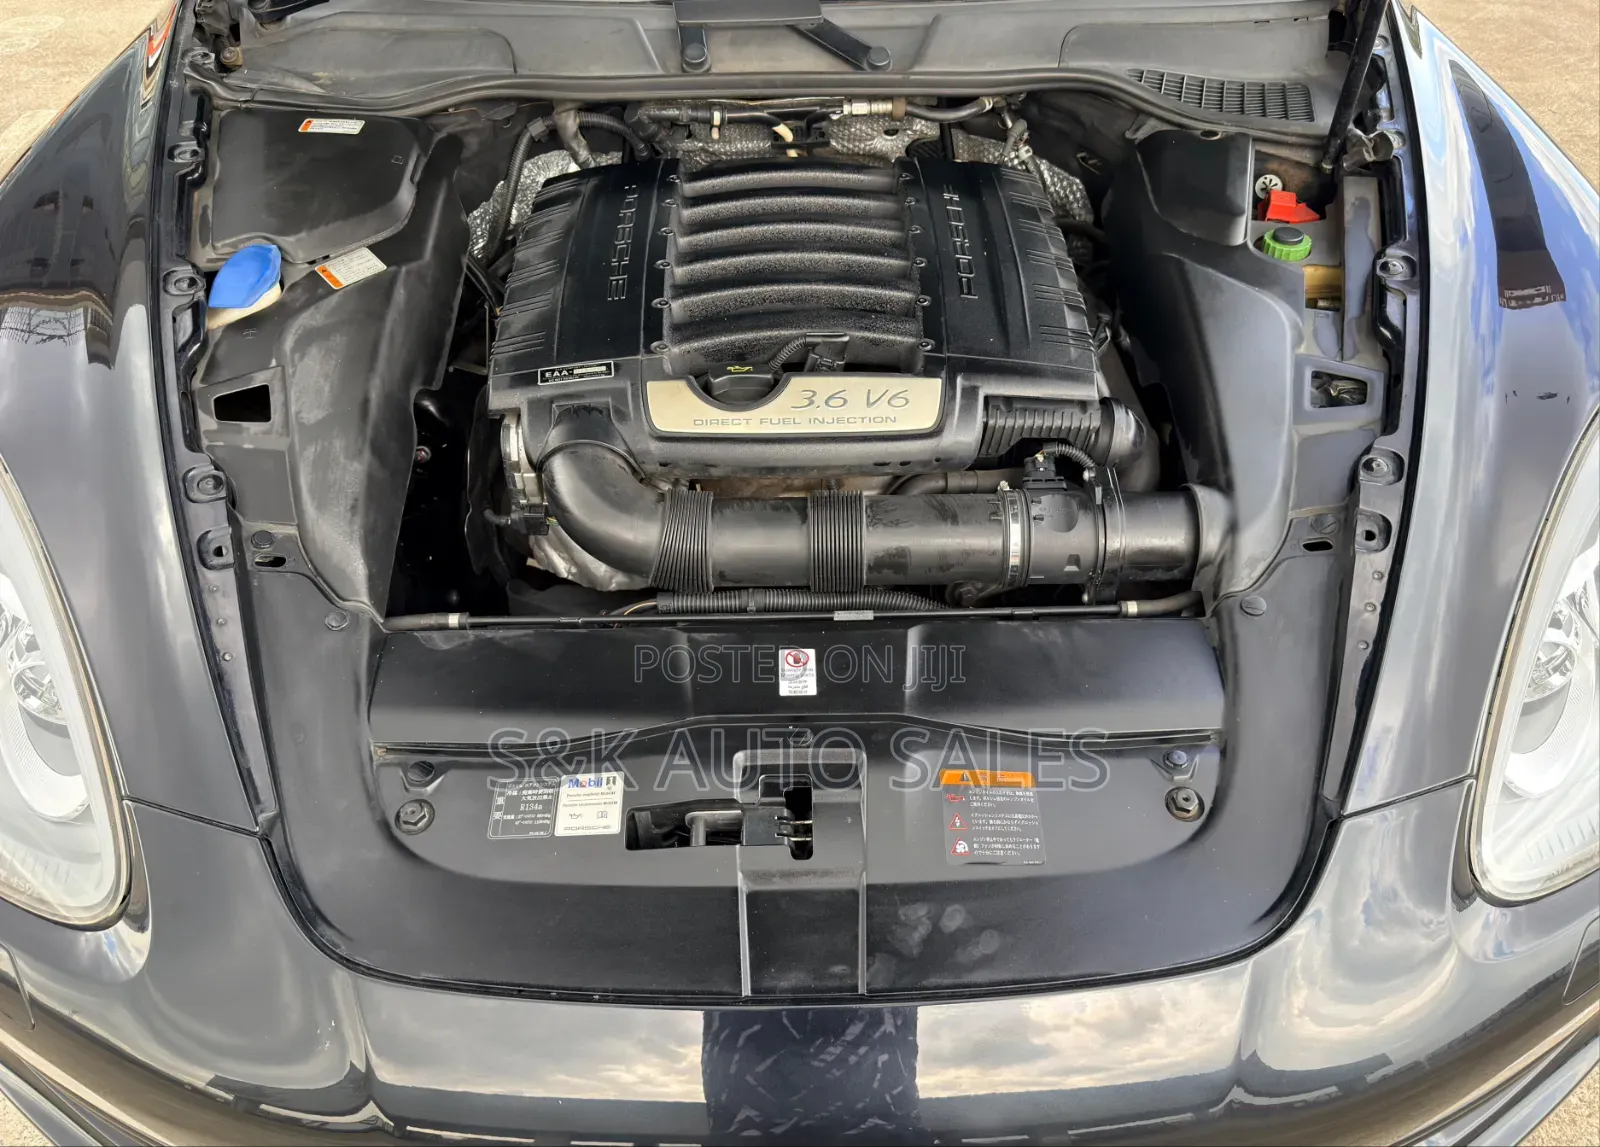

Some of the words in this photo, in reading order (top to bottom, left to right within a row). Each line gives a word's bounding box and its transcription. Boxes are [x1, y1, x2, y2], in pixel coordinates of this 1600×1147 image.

[607, 184, 638, 300] PORSCHE
[943, 184, 978, 299] PORSCHE
[791, 389, 849, 409] 3.6
[866, 389, 910, 409] V6
[693, 418, 752, 426] DIRECT
[759, 417, 801, 425] FUEL
[809, 416, 897, 424] INJECTION
[568, 777, 603, 788] Mobil
